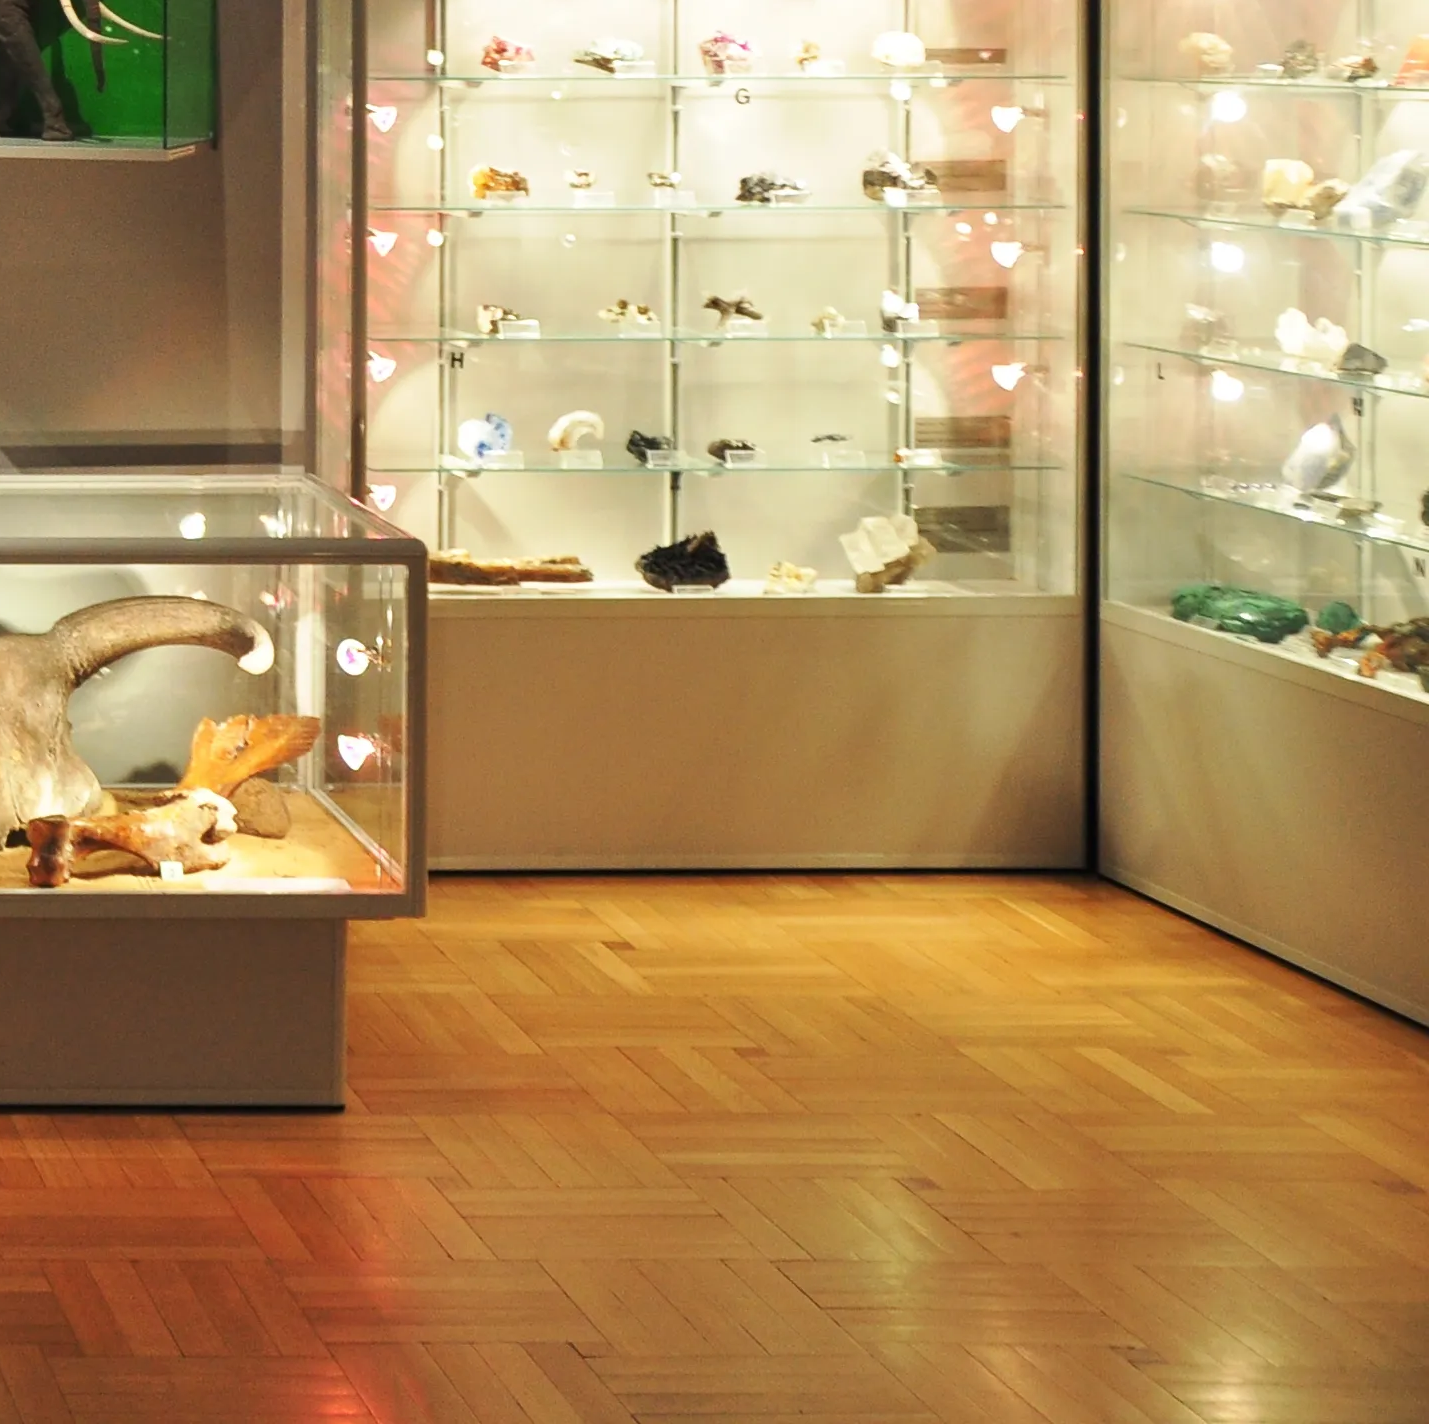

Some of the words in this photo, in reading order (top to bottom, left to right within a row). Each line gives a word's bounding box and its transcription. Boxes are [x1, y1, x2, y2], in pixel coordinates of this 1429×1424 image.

[735, 87, 751, 105] G
[451, 351, 464, 369] H
[1157, 362, 1166, 381] L
